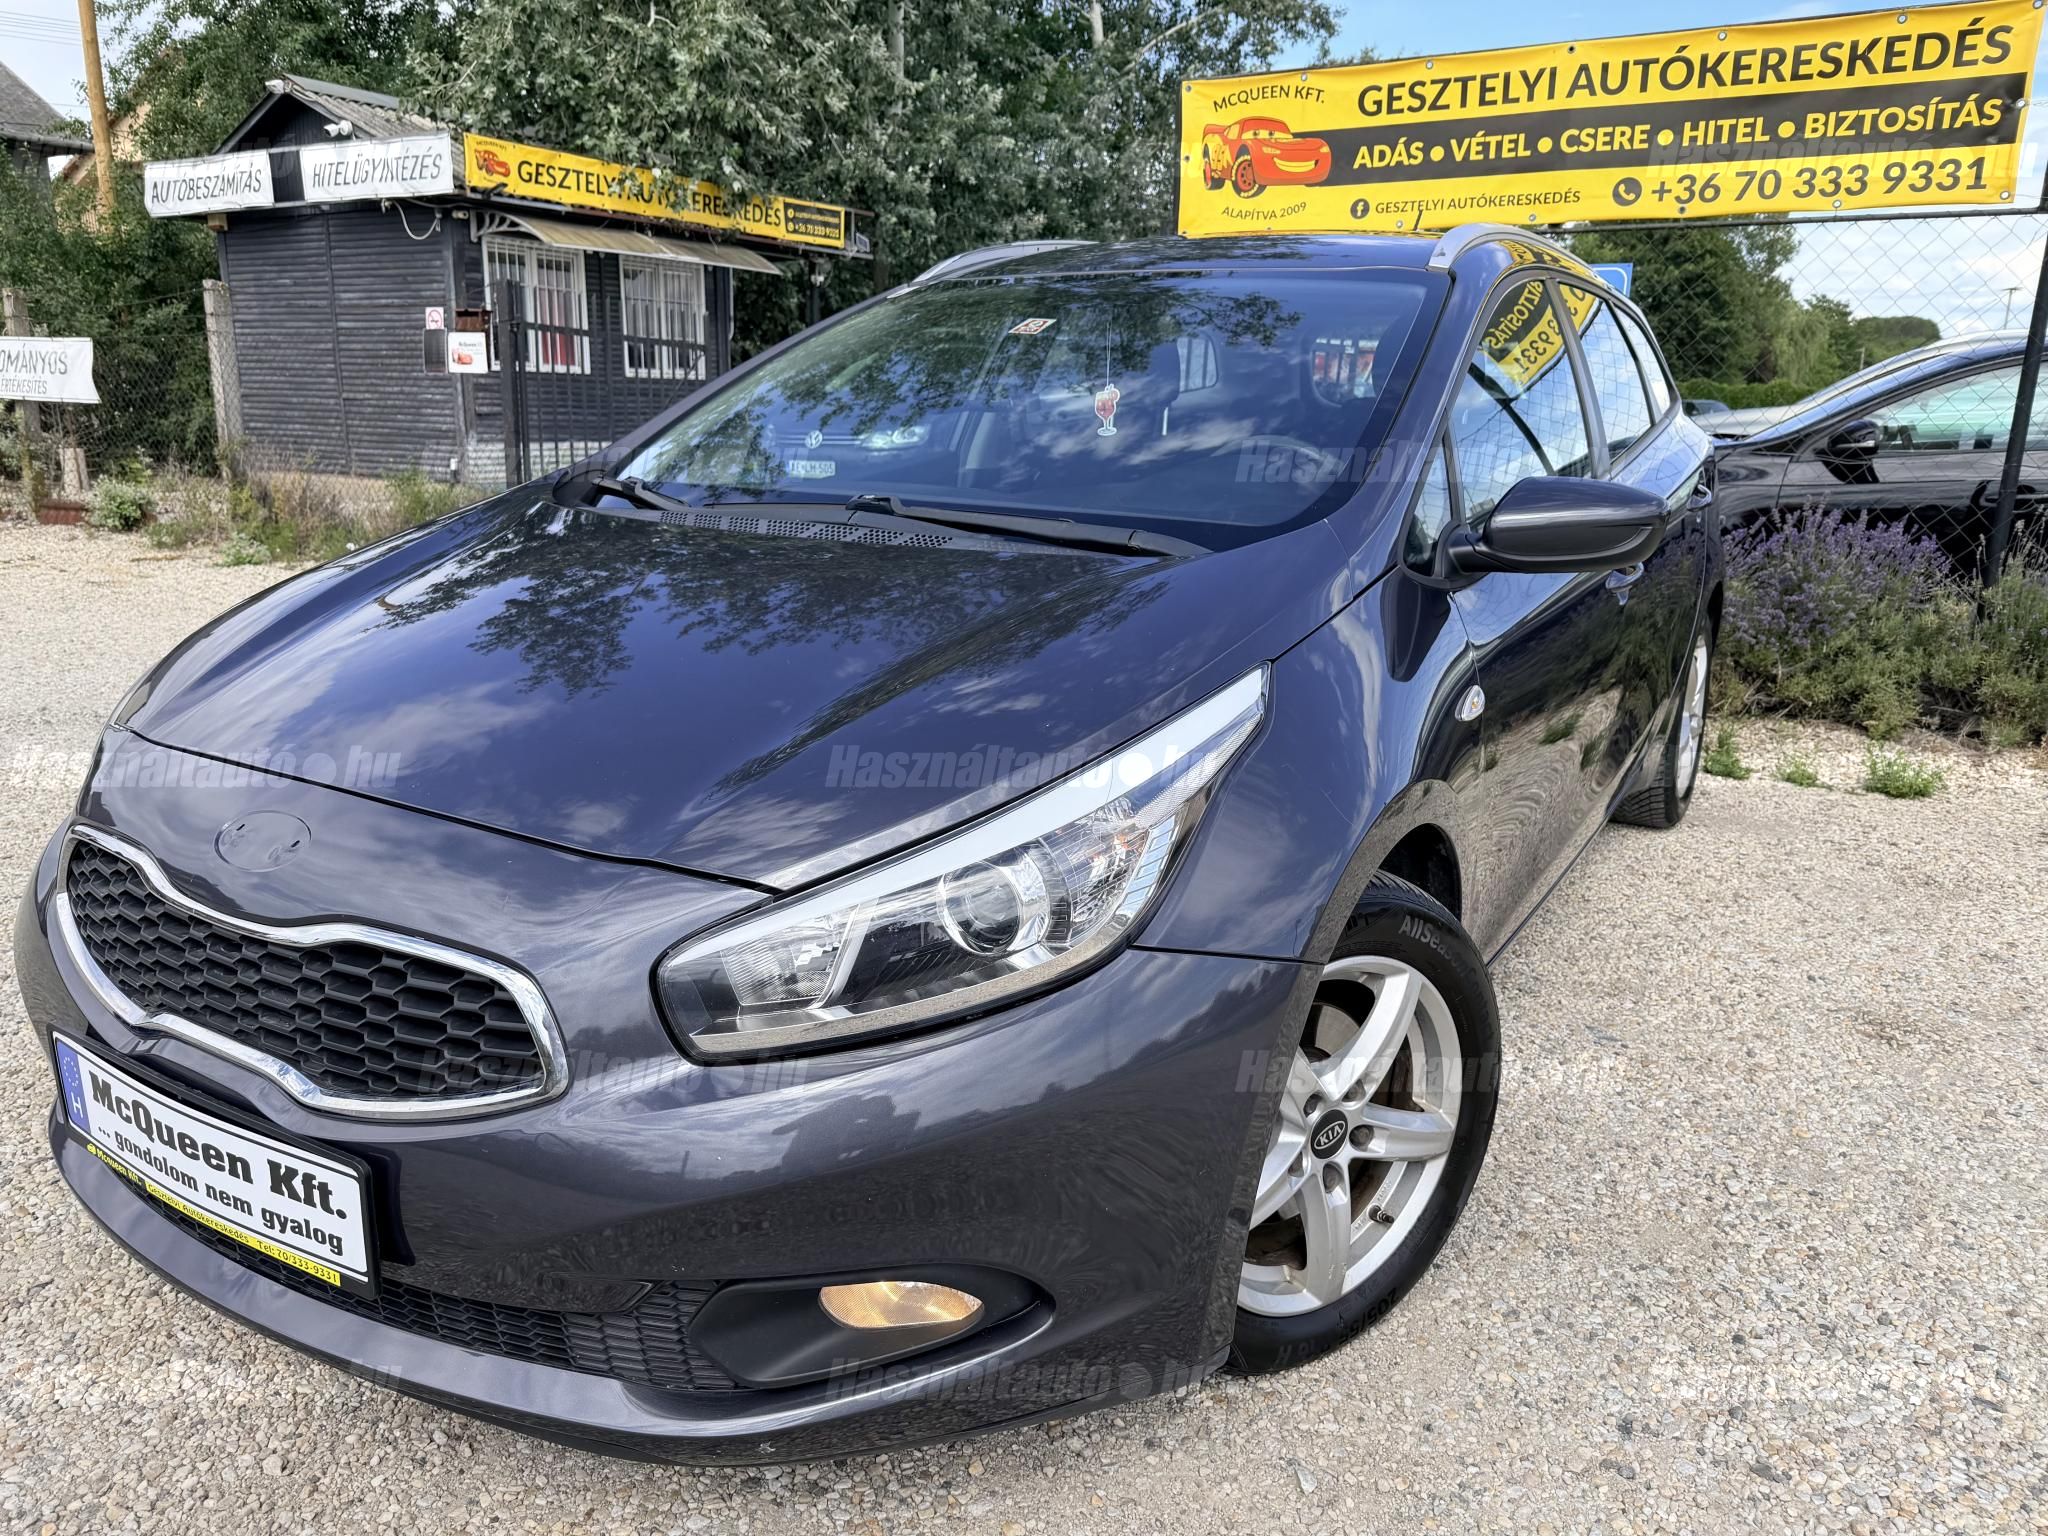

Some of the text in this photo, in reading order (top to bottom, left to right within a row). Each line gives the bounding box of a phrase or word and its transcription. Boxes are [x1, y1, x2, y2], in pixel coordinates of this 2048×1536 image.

[1357, 16, 2014, 117] GESZTELYI AUTÓKERESKEDÉS
[1213, 85, 1325, 112] MCQUEEN KFT.
[1352, 93, 2003, 169] ADÁS VÉTEL CSERE HITEL BIZTOSÍTÁS
[151, 162, 262, 204] AUTÓBESZÁMÍTÁS
[312, 146, 442, 188] HITELÜGYINTÉZÉS
[1651, 156, 1988, 203] +36 70 333 9331
[1221, 201, 1307, 220] ALAPÍTVA 2009
[1375, 187, 1581, 214] GESZTELYI AUTÓKERESKEDÉS
[71, 1091, 84, 1119] H
[88, 1069, 348, 1220] McQueen Kft.
[1320, 1124, 1342, 1146] KIA
[114, 1130, 200, 1193] gondolom
[204, 1182, 254, 1217] nem
[261, 1207, 344, 1257] gyalog
